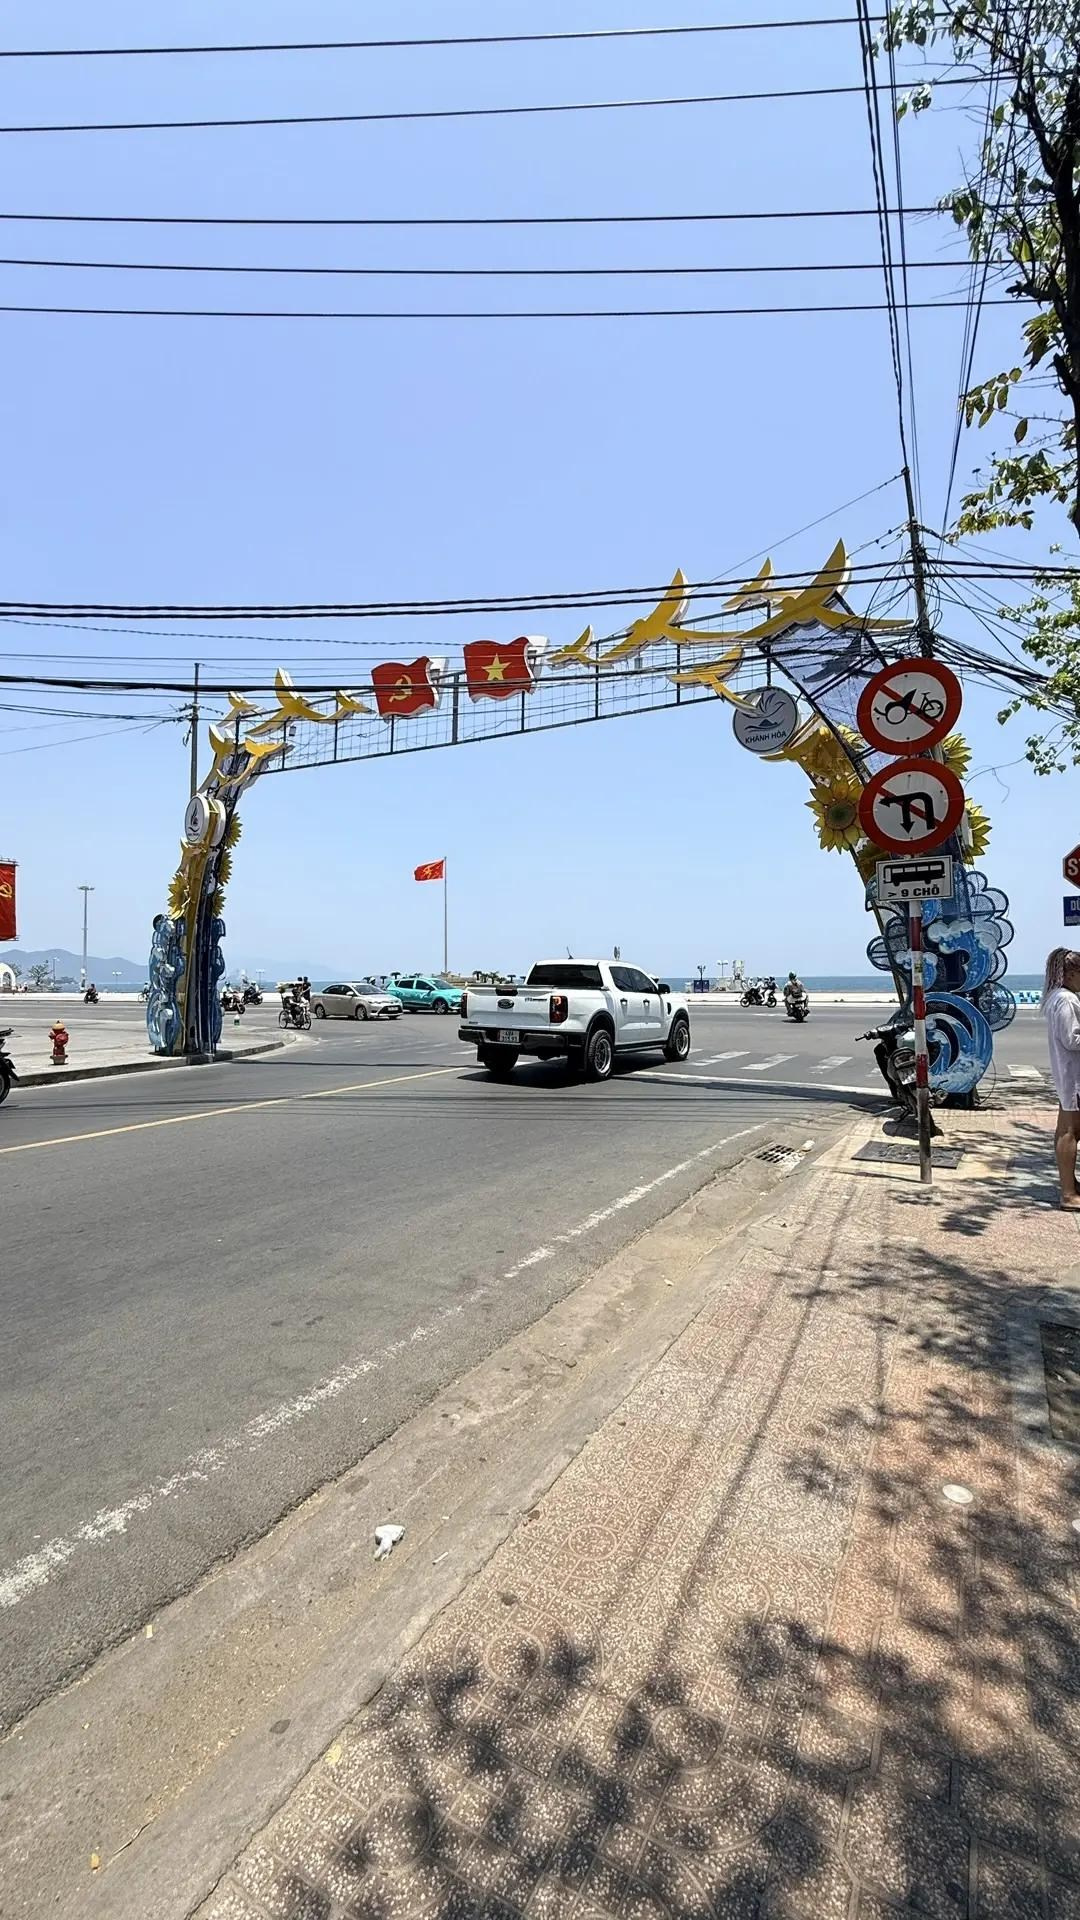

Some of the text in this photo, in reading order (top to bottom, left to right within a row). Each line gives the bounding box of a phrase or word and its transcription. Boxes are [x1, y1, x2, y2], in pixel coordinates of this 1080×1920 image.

[745, 733, 770, 744] KHÁNH
[1067, 858, 1080, 876] S
[901, 888, 909, 897] 9
[913, 883, 940, 896] CHỖ
